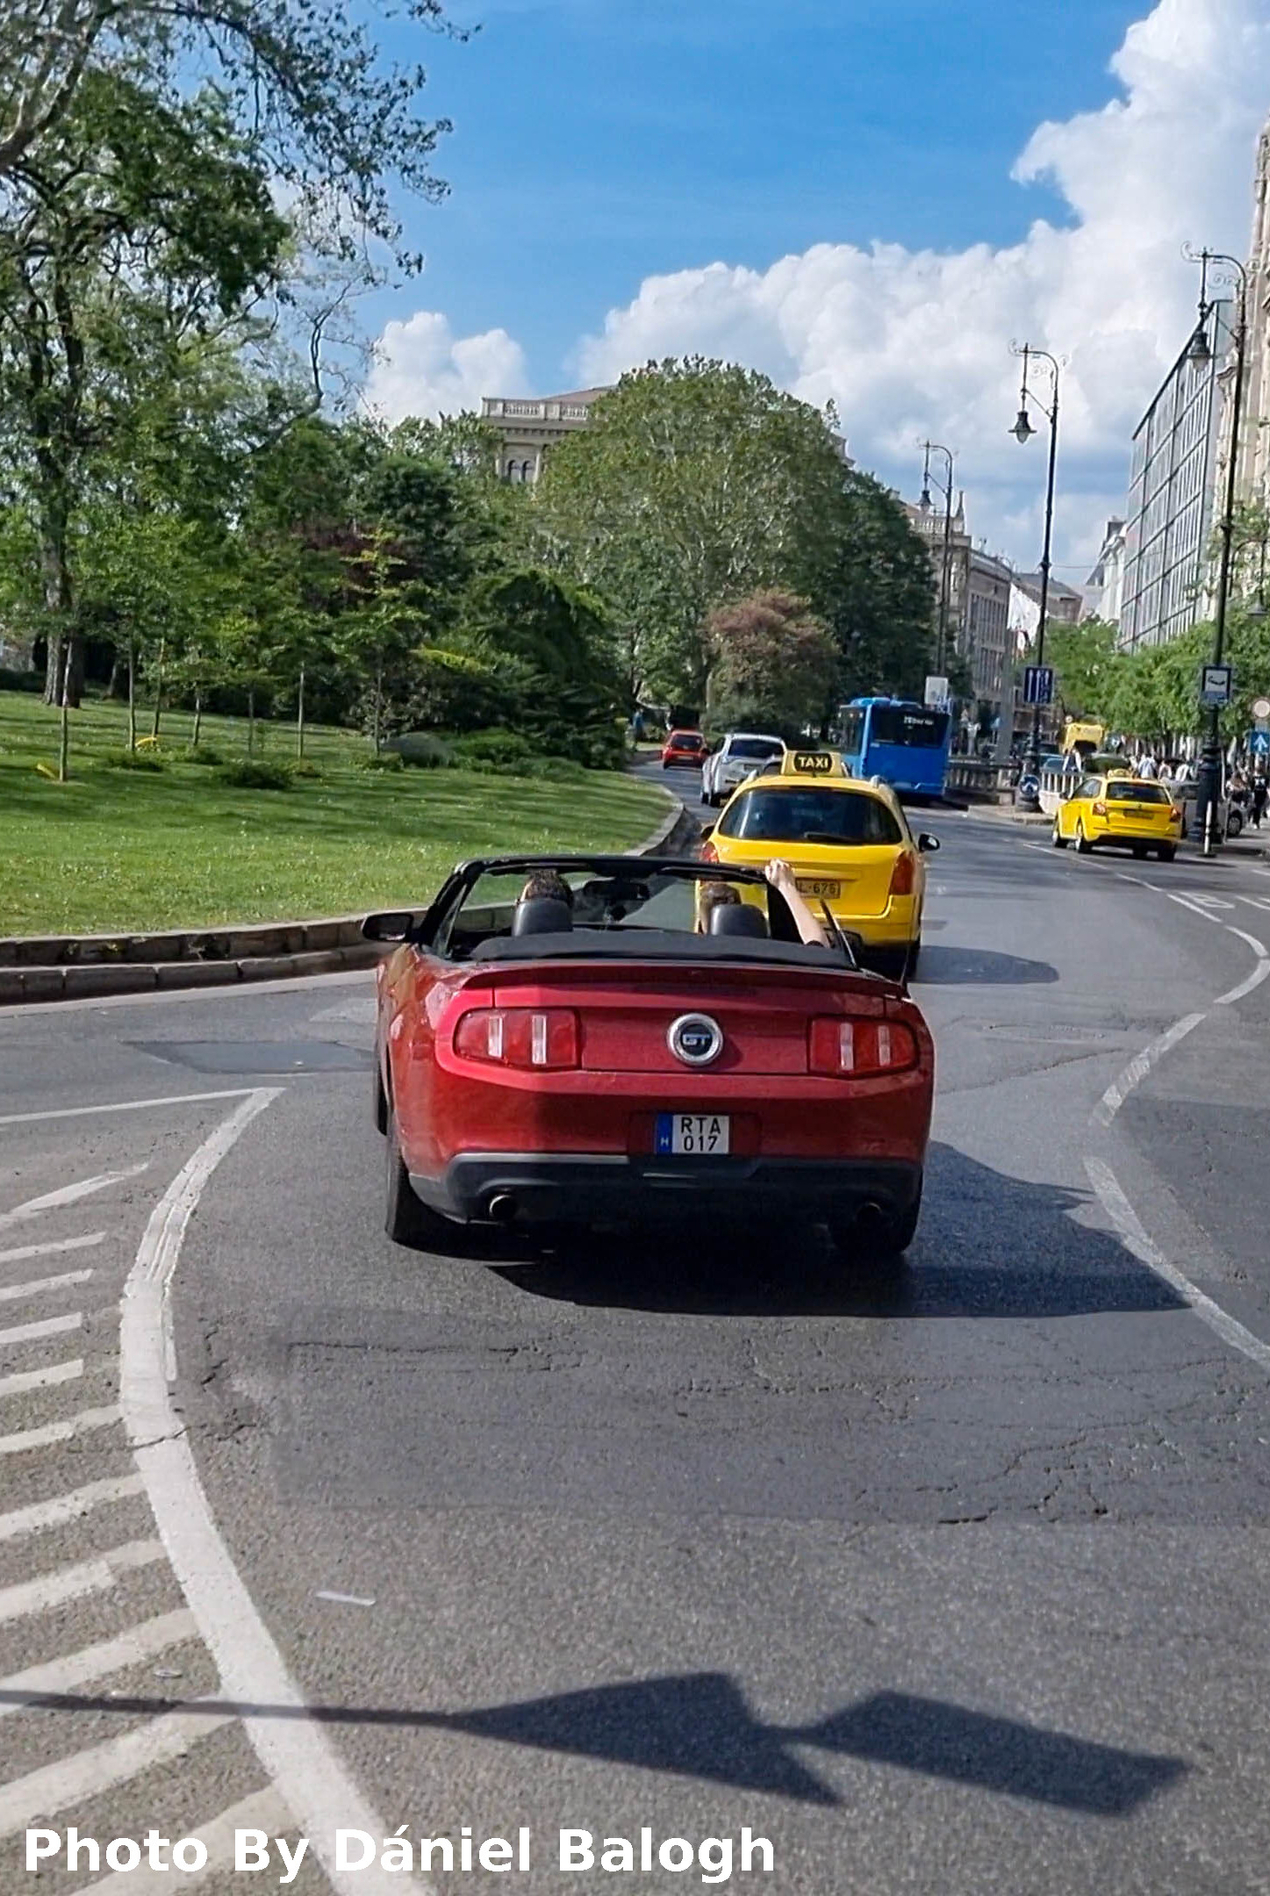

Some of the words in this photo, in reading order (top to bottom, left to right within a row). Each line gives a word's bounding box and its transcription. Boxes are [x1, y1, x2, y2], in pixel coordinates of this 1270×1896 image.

[798, 756, 829, 769] TAXI
[682, 1033, 710, 1046] GT
[681, 1116, 721, 1134] RTA
[683, 1135, 718, 1152] 017
